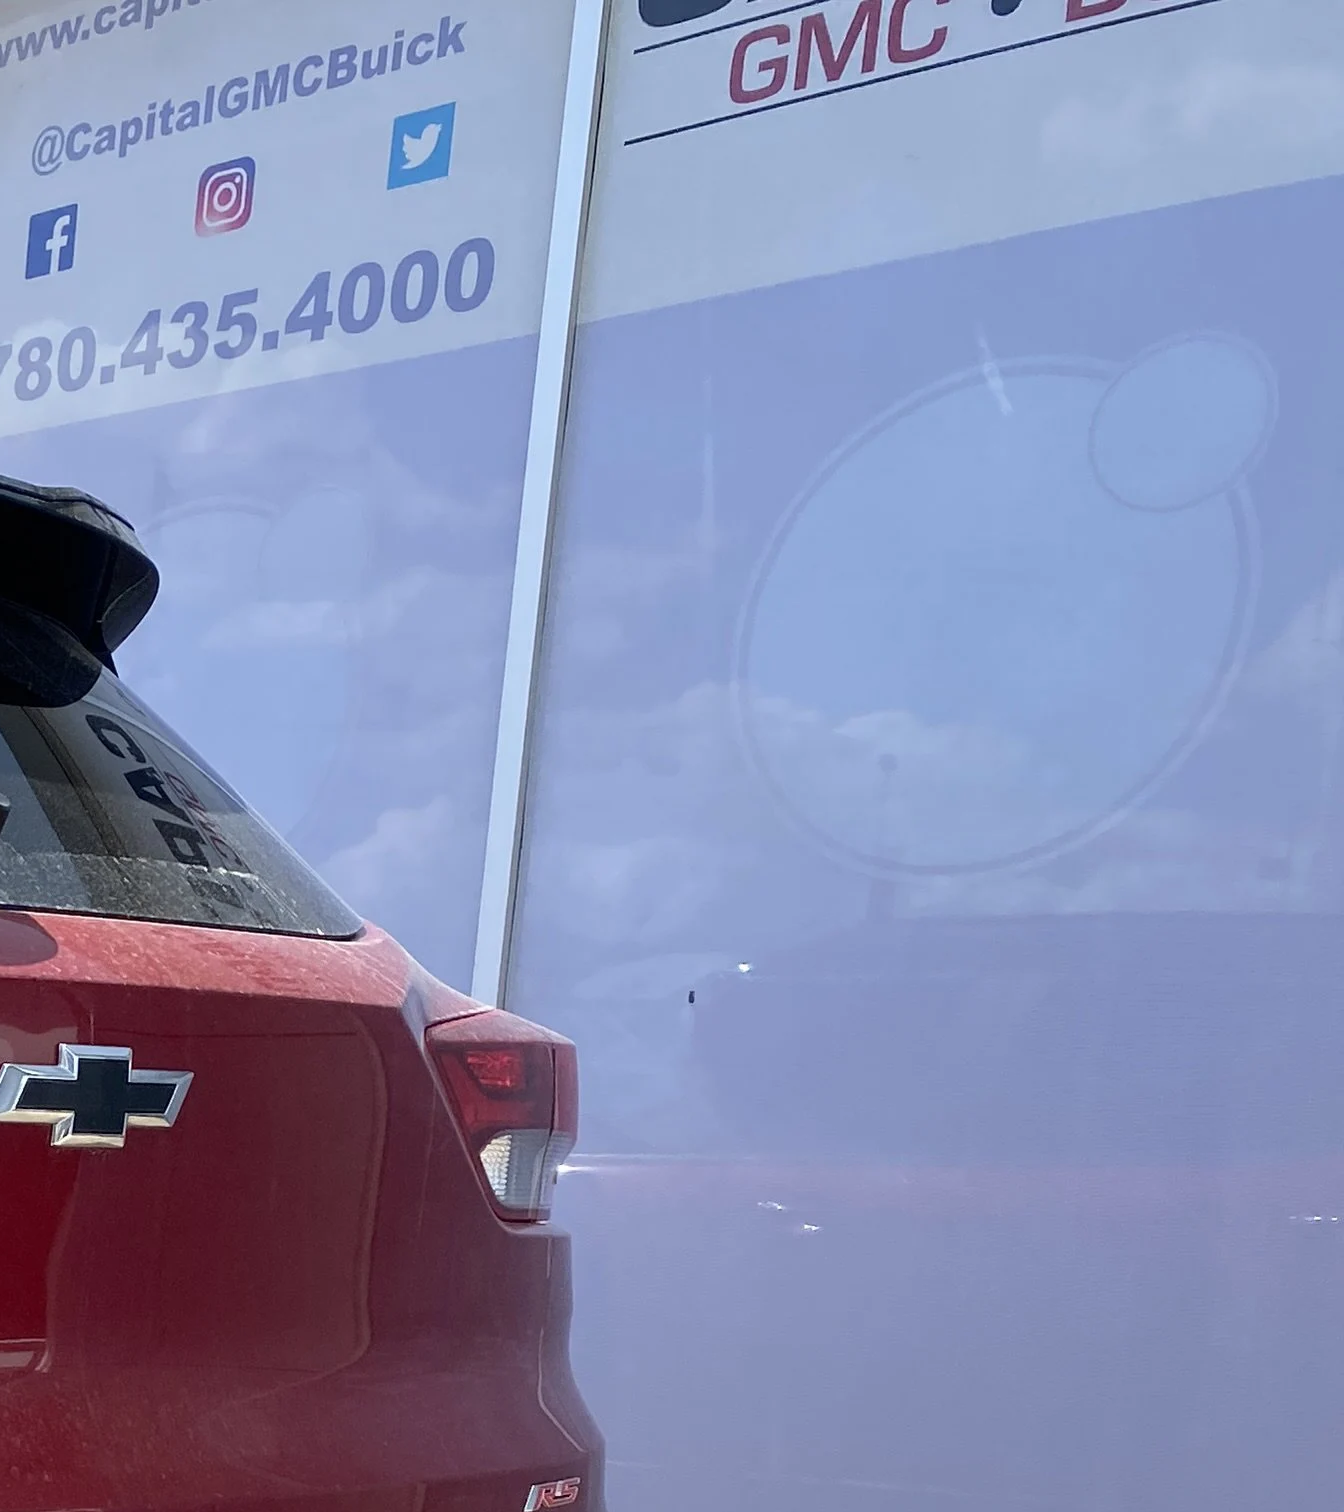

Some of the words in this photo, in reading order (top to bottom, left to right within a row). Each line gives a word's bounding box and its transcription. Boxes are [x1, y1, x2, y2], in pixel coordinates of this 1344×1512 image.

[31, 16, 468, 176] @CapitalGMCBuick
[729, 0, 949, 104] GMC
[523, 1477, 581, 1512] RS
